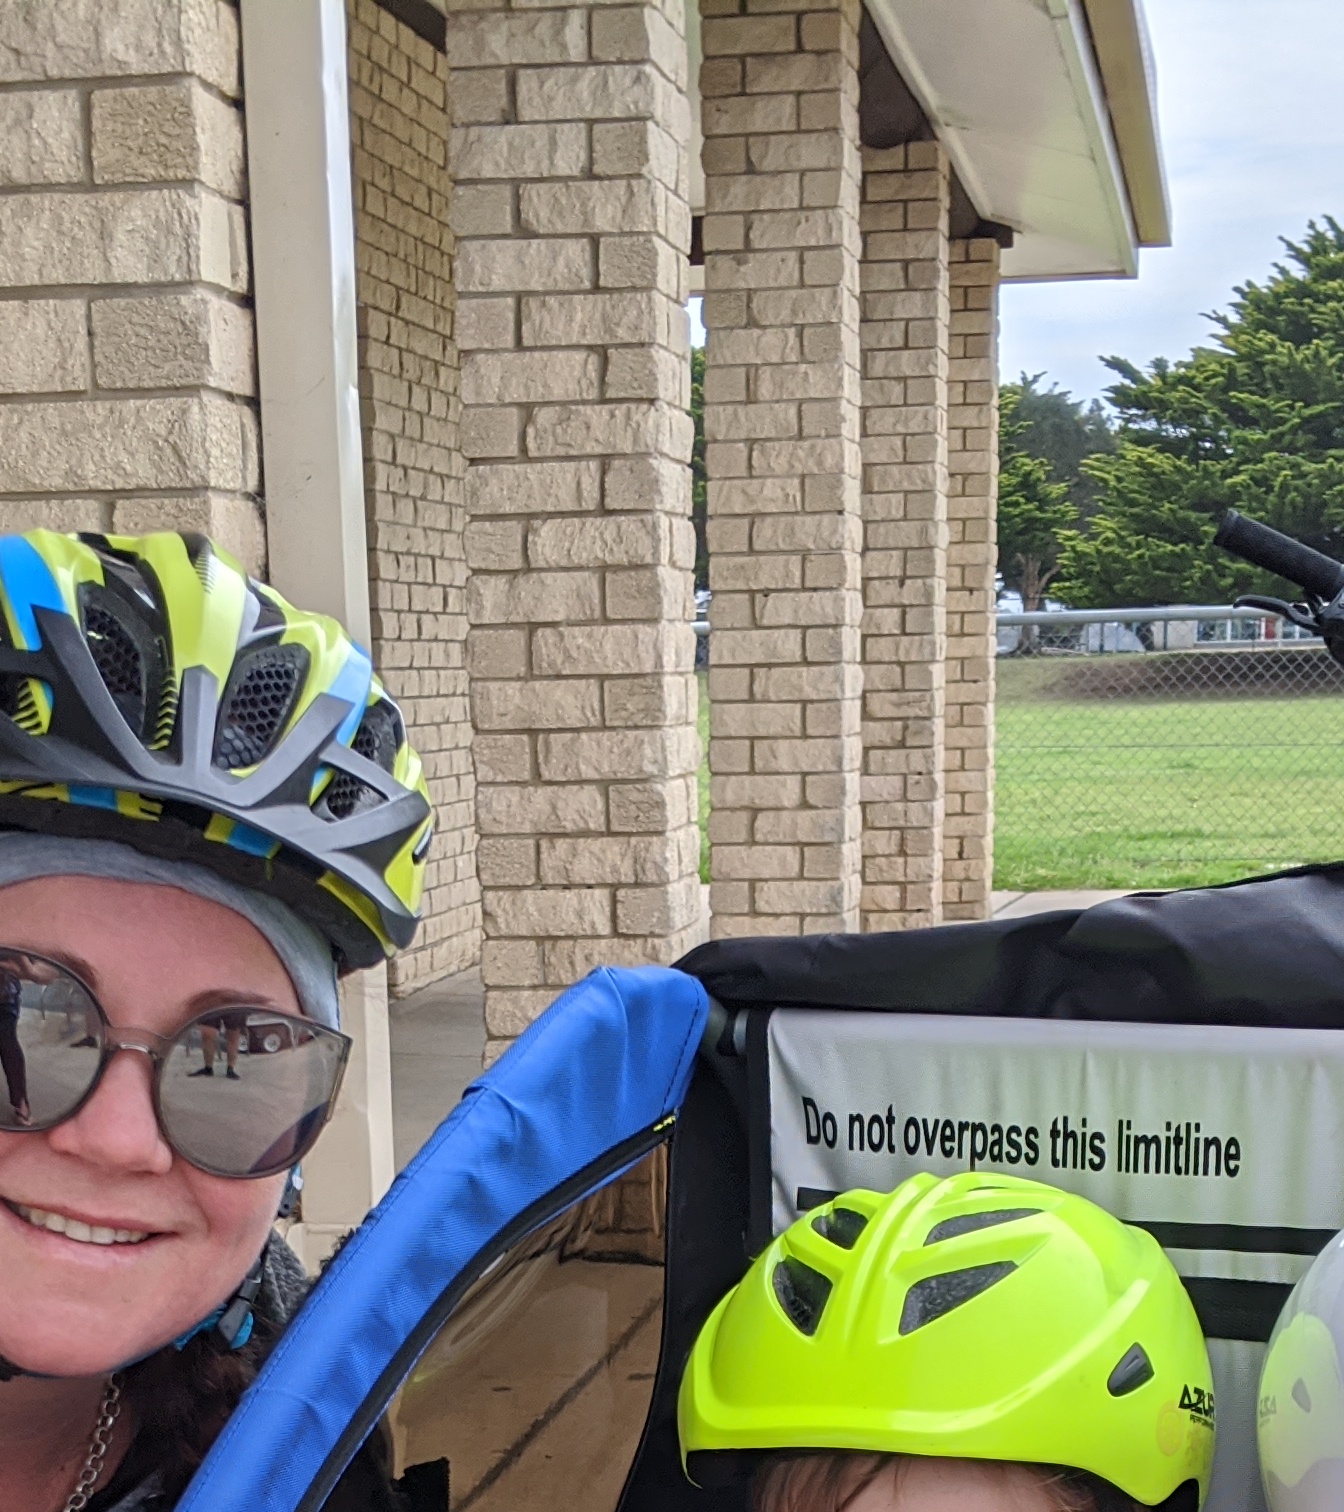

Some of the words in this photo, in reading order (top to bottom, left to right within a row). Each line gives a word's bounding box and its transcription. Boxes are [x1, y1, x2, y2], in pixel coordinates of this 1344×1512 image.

[801, 1096, 838, 1150] Do
[848, 1103, 896, 1154] not
[903, 1115, 1041, 1172] overpass
[1049, 1115, 1107, 1172] this
[1116, 1118, 1242, 1178] limitline
